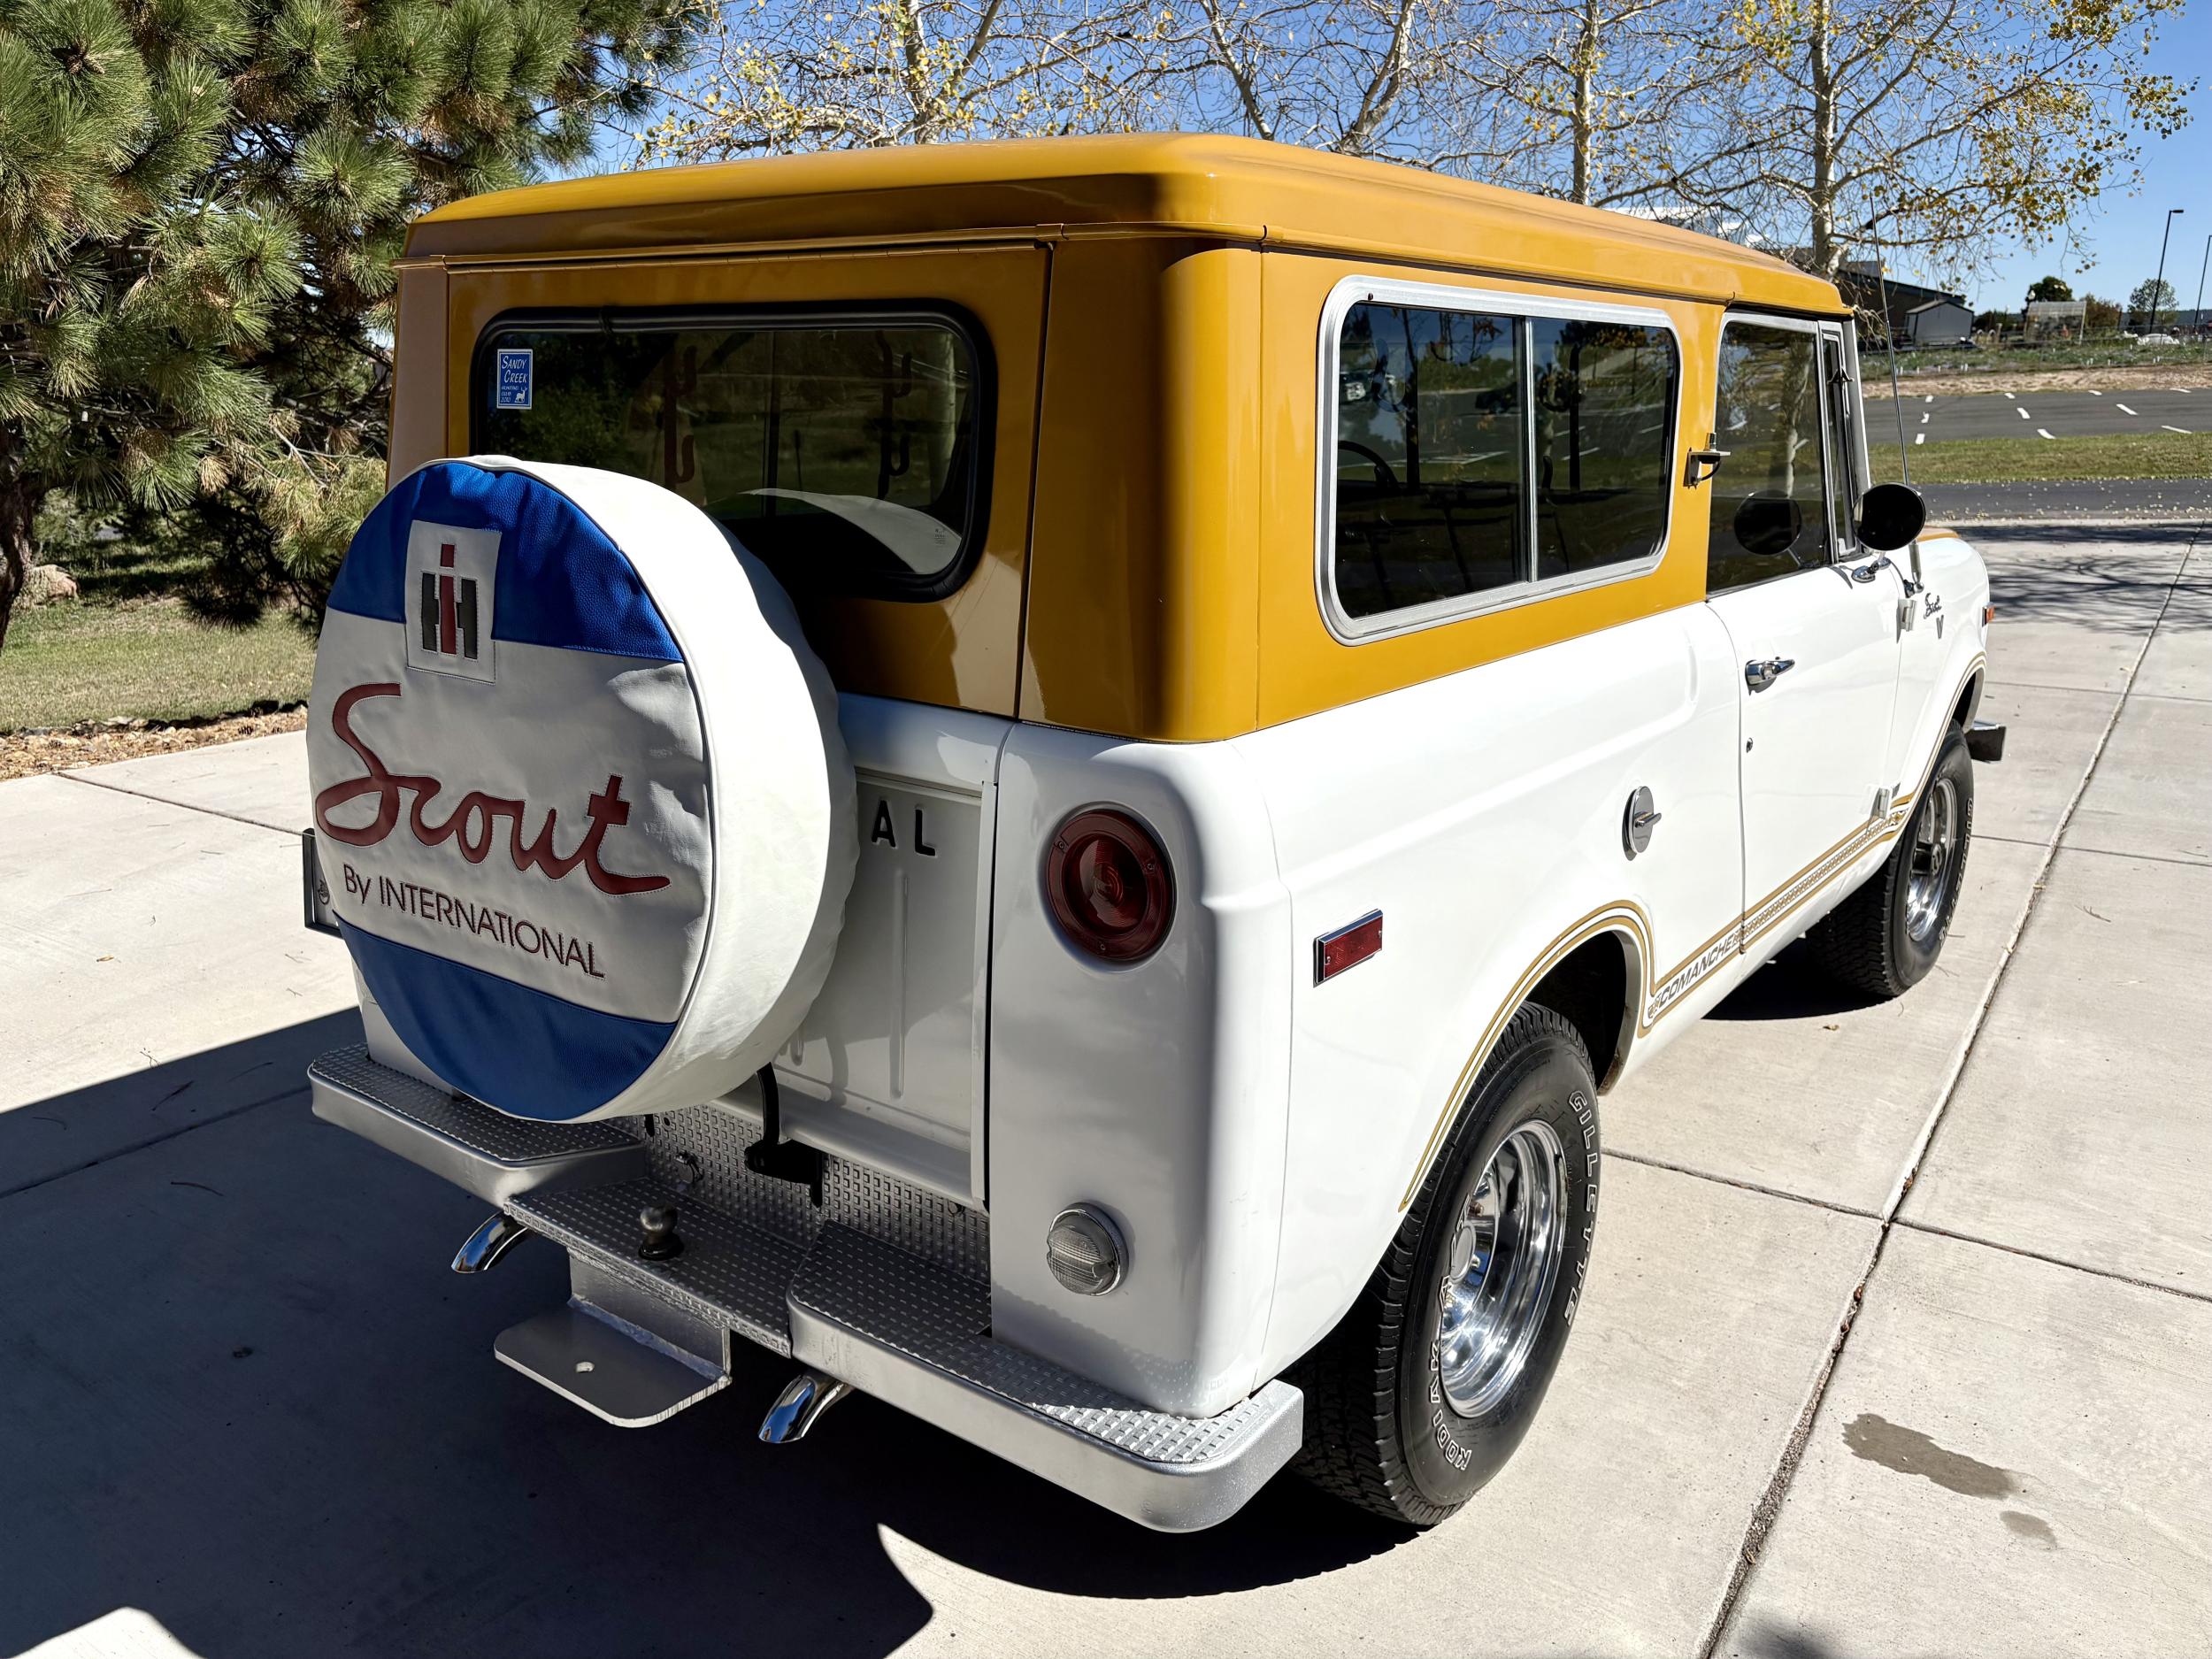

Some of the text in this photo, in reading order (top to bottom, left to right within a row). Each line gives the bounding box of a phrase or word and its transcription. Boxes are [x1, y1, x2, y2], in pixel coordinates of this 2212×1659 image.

[502, 356, 527, 369] SANDY
[503, 370, 528, 383] CREEK
[314, 682, 672, 896] Scout
[379, 875, 605, 979] INTERNATIONAL
[1658, 933, 1736, 1009] COMANCHE
[1563, 1090, 1598, 1327] GILLETTE
[1430, 1341, 1472, 1471] KODIAK
